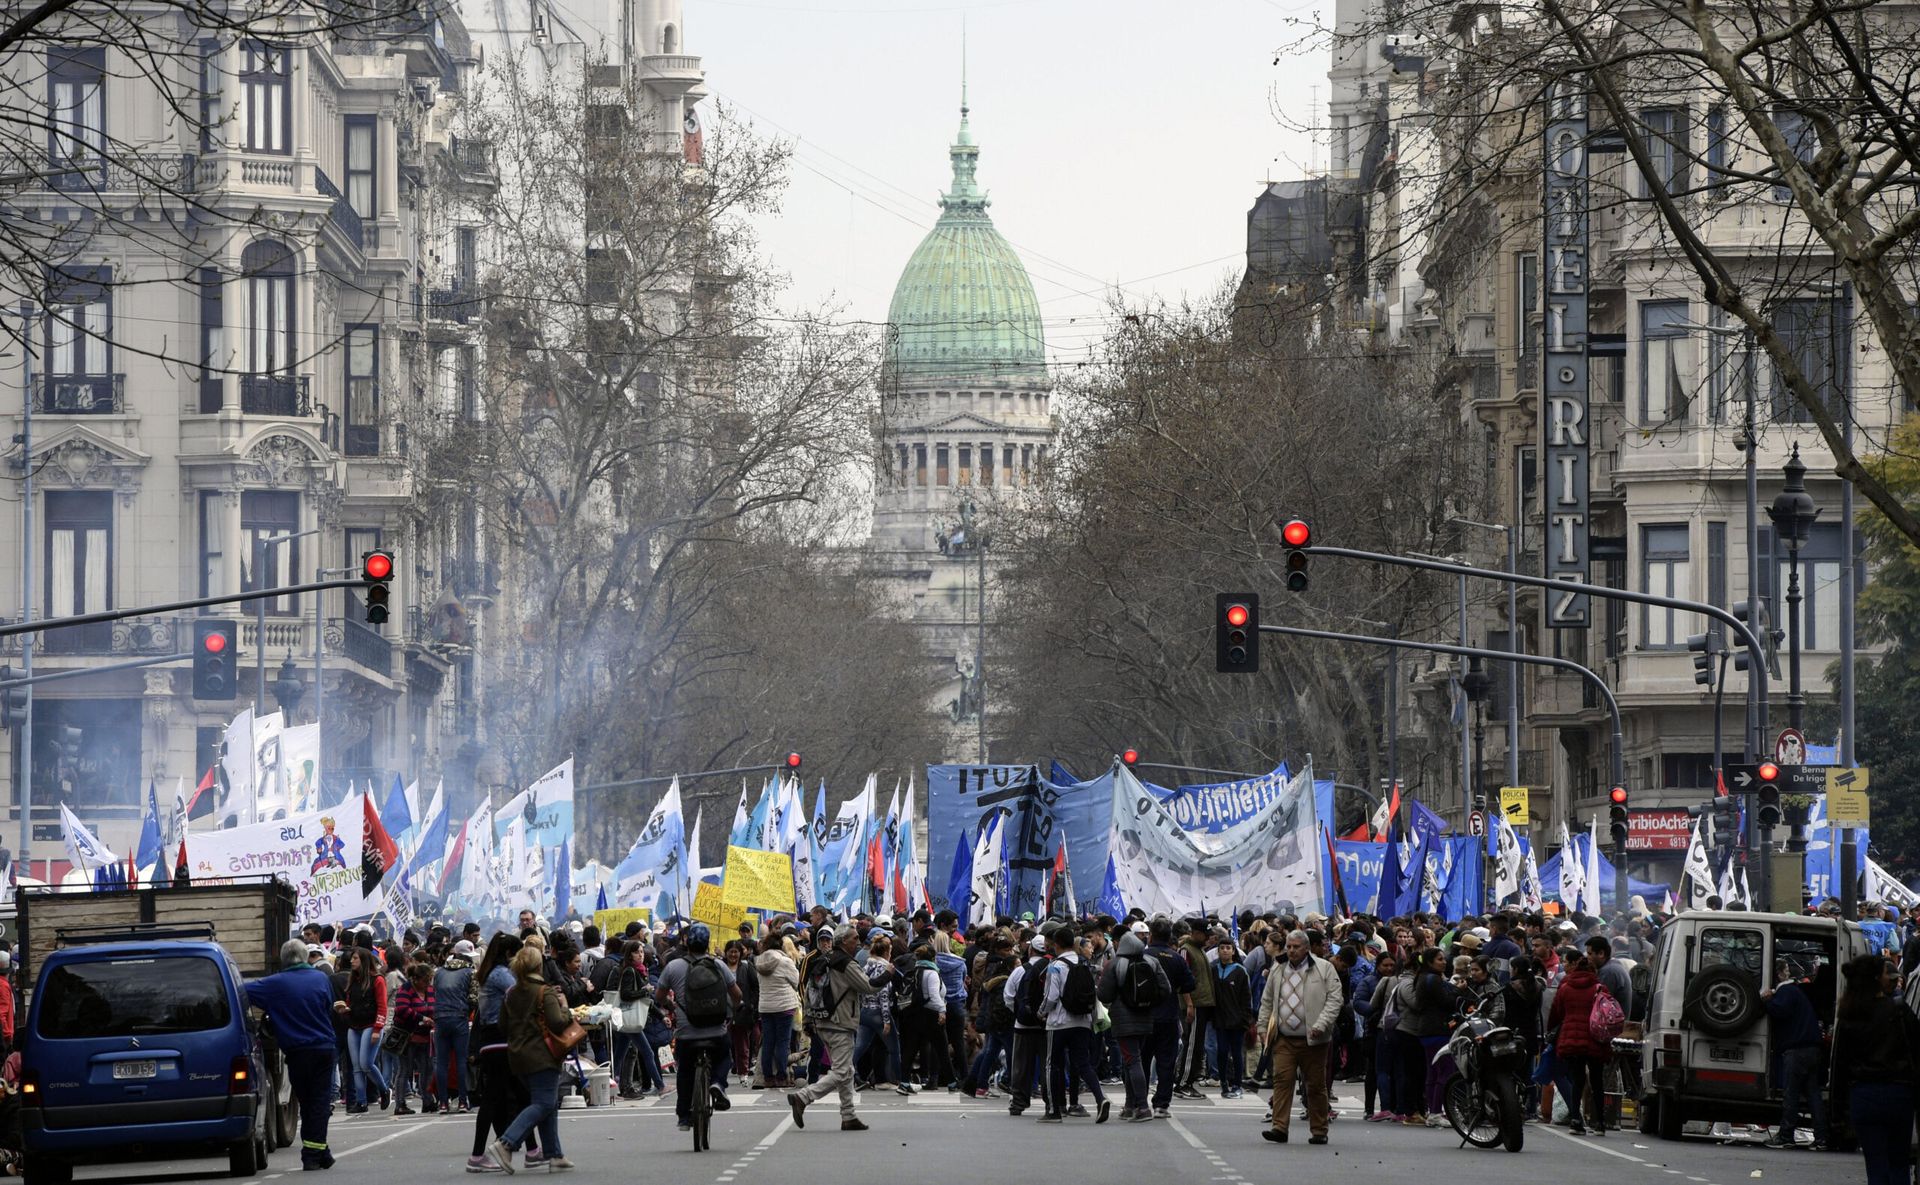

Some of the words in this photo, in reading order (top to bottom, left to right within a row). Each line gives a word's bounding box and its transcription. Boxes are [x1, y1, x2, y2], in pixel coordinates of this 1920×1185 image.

[1549, 73, 1587, 354] HOTEL
[1549, 396, 1587, 622] RITZ
[1802, 766, 1825, 774] Berna
[1806, 775, 1825, 783] Irigo
[1628, 813, 1689, 830] oribioAchá
[138, 1063, 154, 1074] 152
